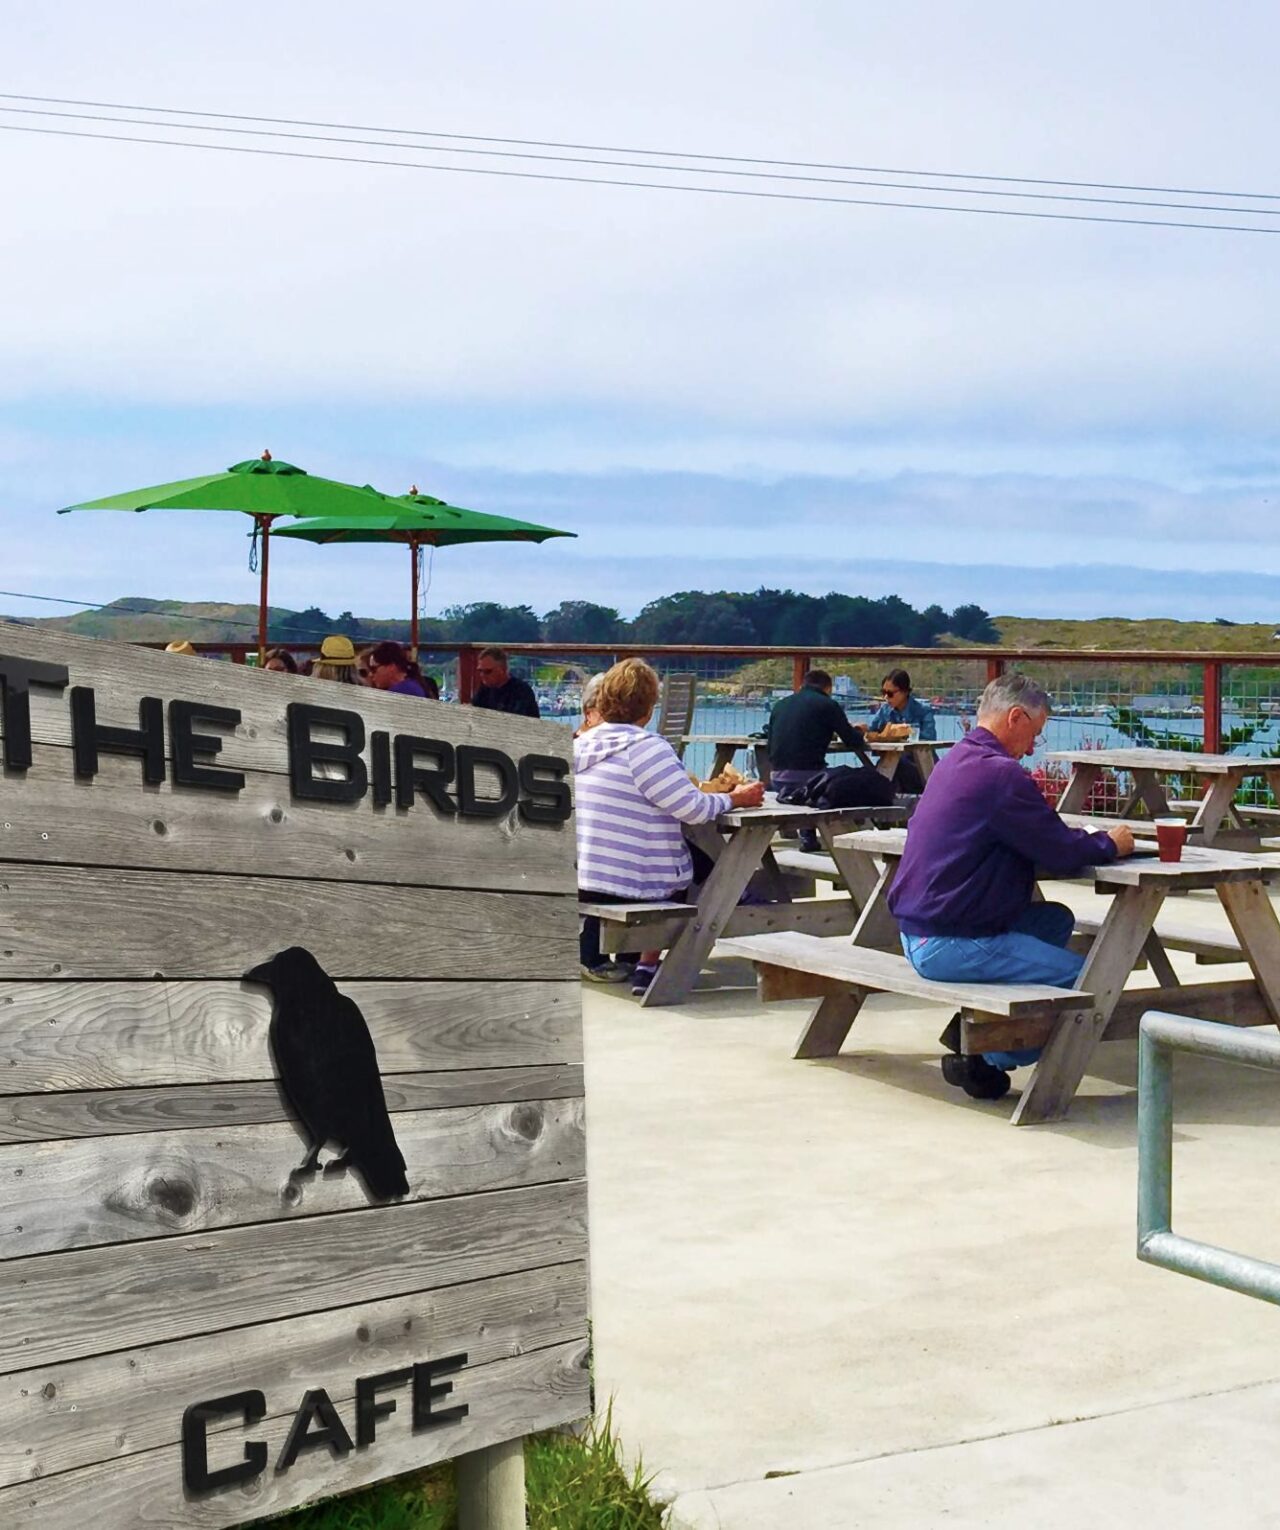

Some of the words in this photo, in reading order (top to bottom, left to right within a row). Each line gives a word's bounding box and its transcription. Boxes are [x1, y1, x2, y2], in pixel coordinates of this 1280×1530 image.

[0, 654, 246, 791] THE
[286, 702, 572, 822] BIRDS
[182, 1352, 469, 1493] CAFE
